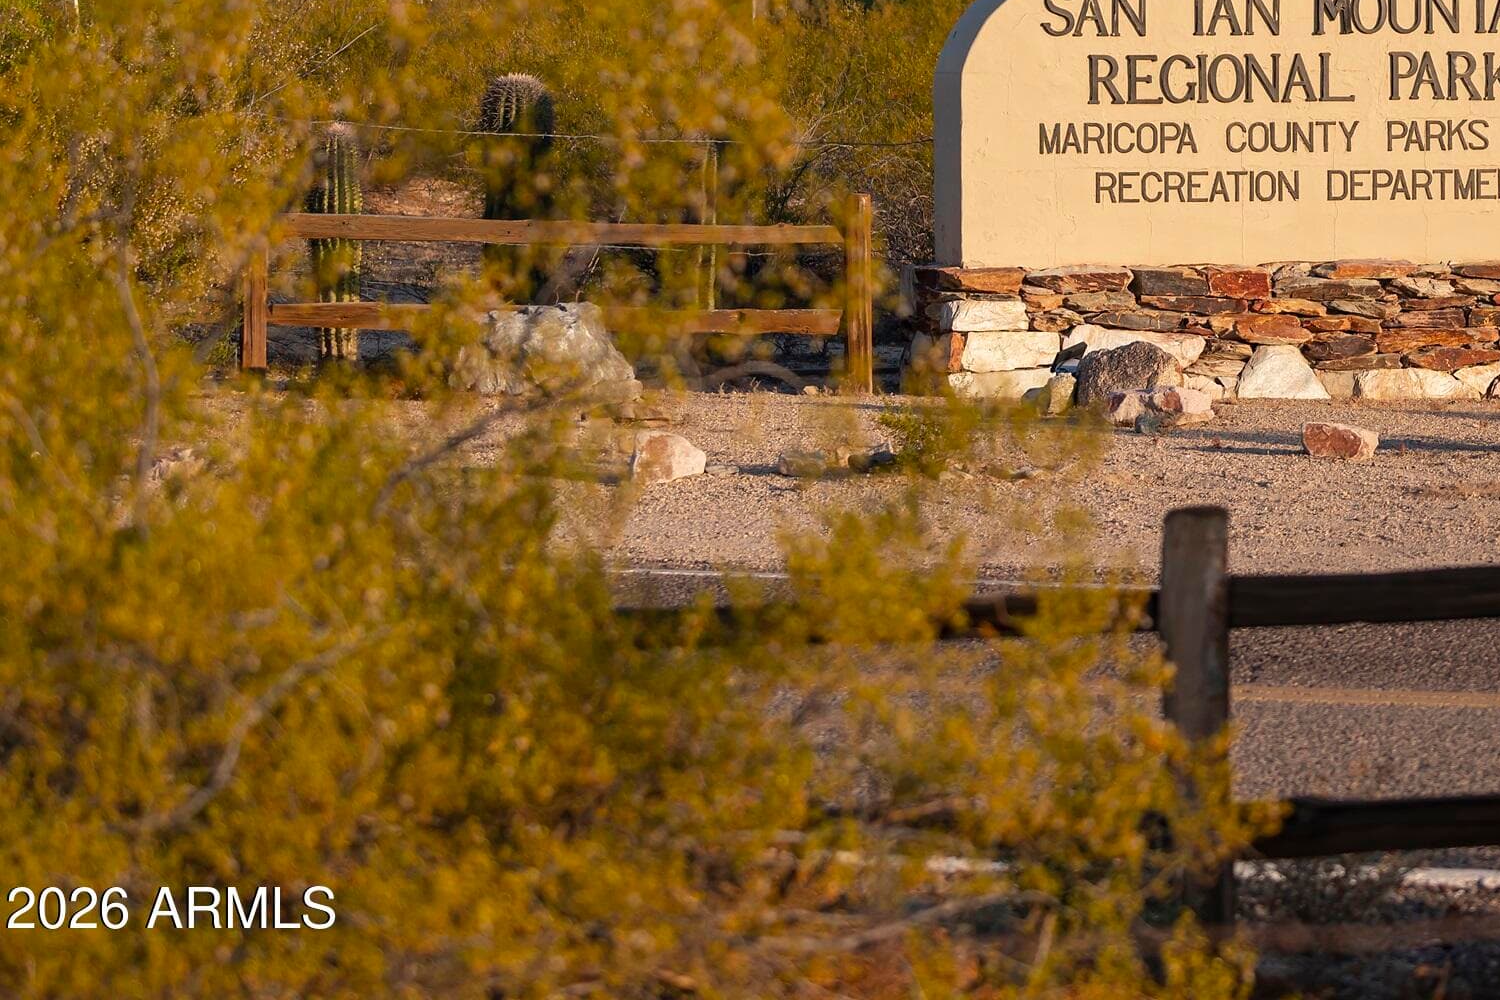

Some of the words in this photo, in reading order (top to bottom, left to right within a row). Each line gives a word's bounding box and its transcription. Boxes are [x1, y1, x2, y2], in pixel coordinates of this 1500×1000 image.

[1087, 52, 1355, 105] REGIONAL
[1039, 121, 1198, 154] MARICOPA
[1226, 120, 1359, 153] COUNTY
[1387, 119, 1489, 152] PARKS
[1095, 171, 1299, 203] RECREATION
